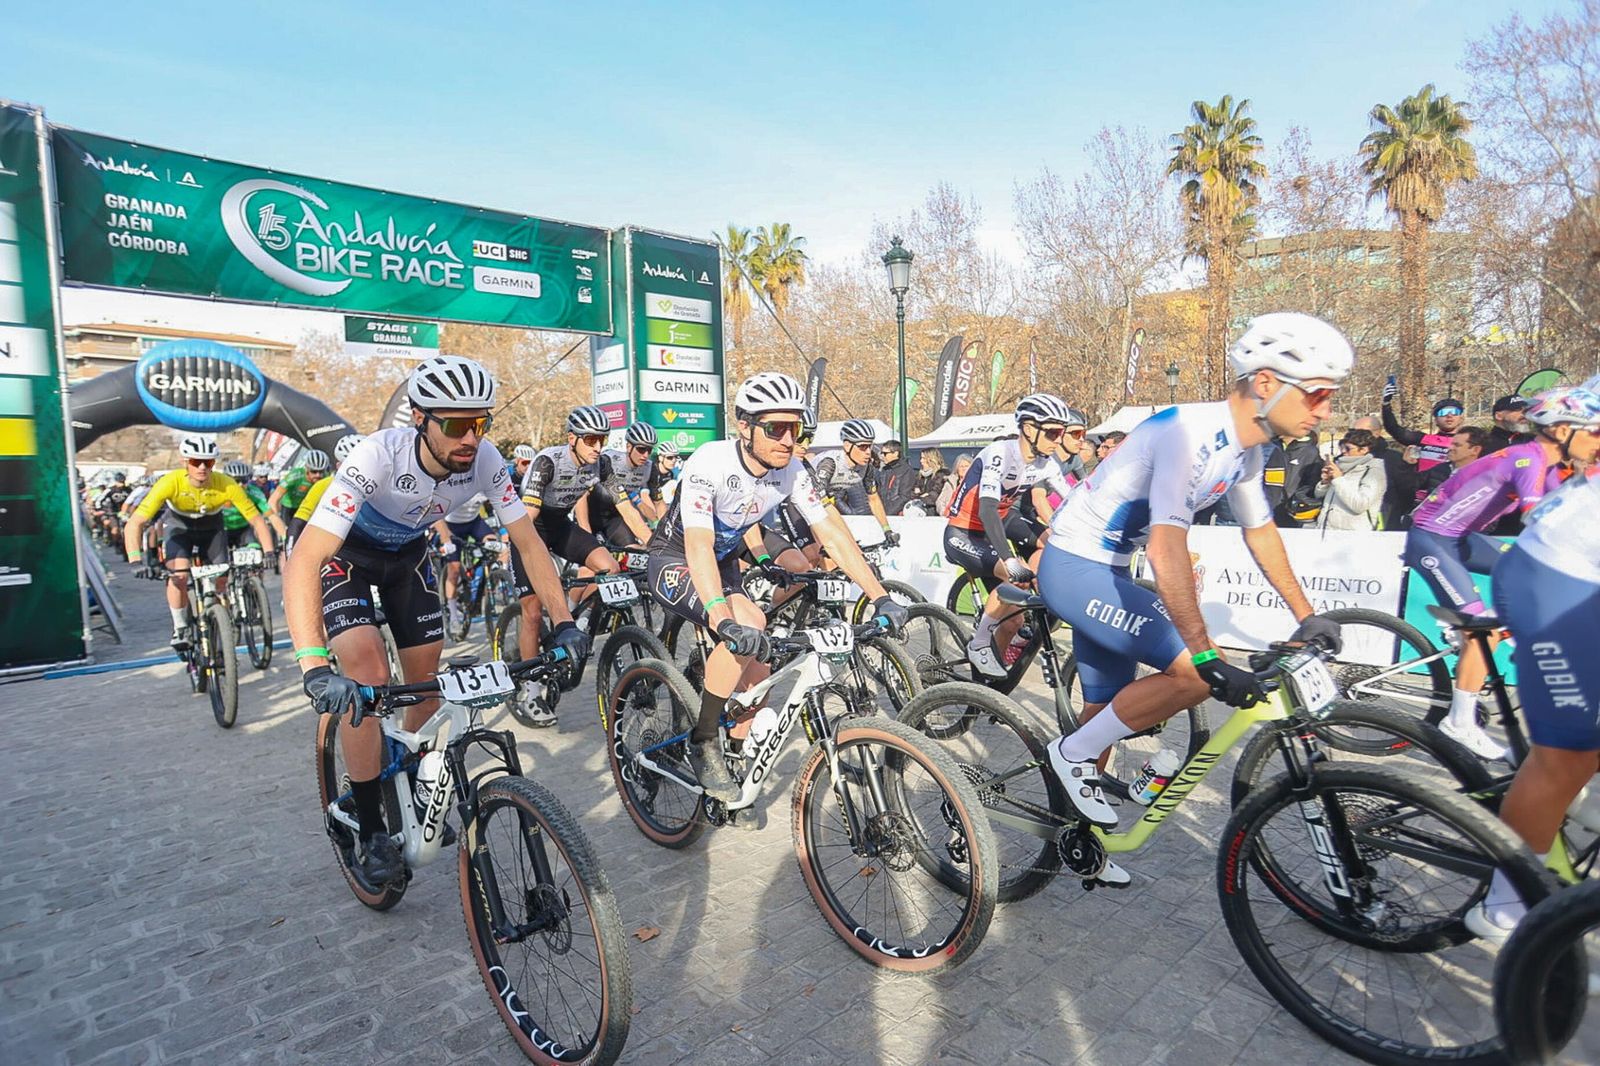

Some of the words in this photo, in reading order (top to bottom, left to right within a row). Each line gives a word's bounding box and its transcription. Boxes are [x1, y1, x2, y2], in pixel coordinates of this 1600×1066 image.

[104, 192, 188, 220] GRANADA
[106, 212, 153, 233] JAÉN
[258, 202, 292, 251] 15
[292, 200, 463, 264] Andalucía
[108, 232, 189, 257] CÓRDOBA
[479, 244, 505, 258] UCI
[295, 241, 374, 280] BIKE
[381, 253, 466, 290] RACE
[481, 274, 535, 290] GARMIN
[366, 321, 409, 334] STAGE
[372, 333, 413, 345] GRANADA
[1126, 343, 1140, 395] ASIC
[149, 373, 256, 396] GARMIN
[596, 381, 624, 395] GARMIN
[653, 380, 710, 395] GARMIN
[940, 360, 954, 417] cannondale
[954, 359, 974, 407] ASIC
[961, 424, 1006, 435] ASIC
[605, 581, 633, 599] 14-2
[823, 581, 846, 598] 14-1
[1226, 591, 1251, 607] DE
[1085, 598, 1150, 637] GOBIK
[815, 626, 849, 648] 13-2
[450, 663, 500, 695] 13-1
[1531, 642, 1592, 713] GOBIK
[753, 703, 801, 785] ORBEA
[1143, 752, 1222, 823] CANYON
